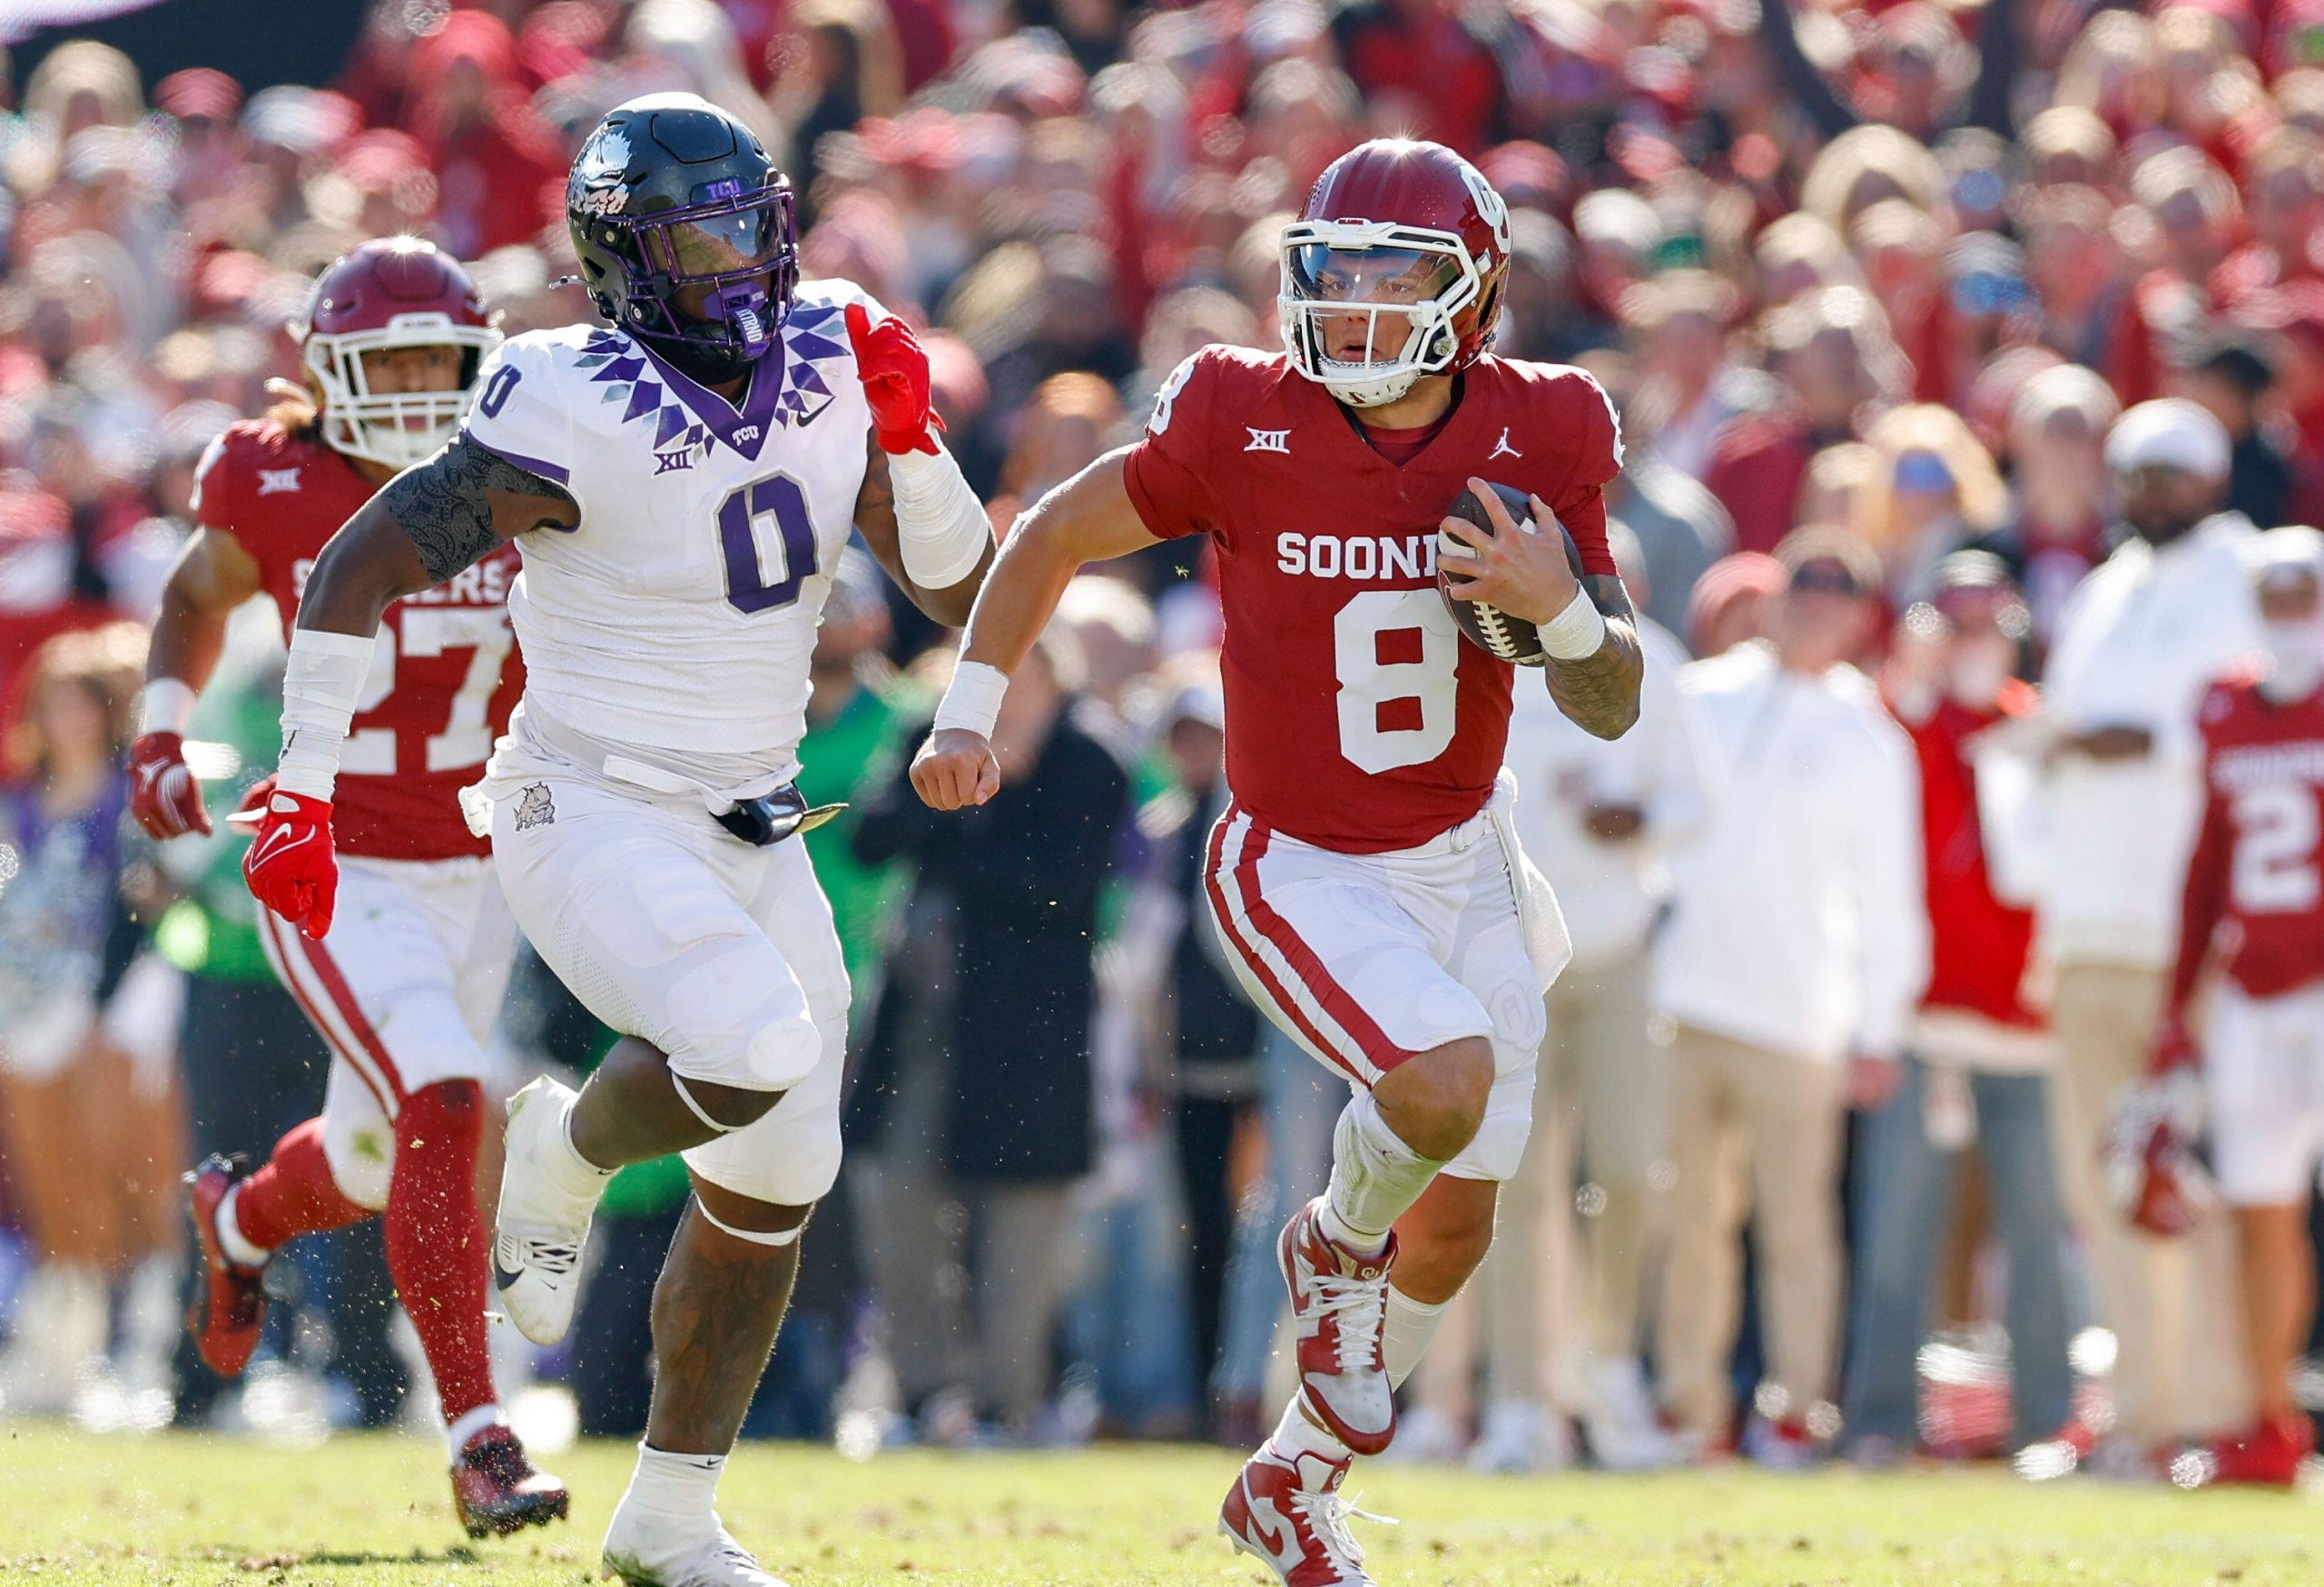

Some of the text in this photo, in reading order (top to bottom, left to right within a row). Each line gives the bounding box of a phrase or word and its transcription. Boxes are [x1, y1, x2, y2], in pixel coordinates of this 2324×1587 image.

[706, 178, 741, 199] TCU
[479, 363, 522, 419] 0
[1148, 360, 1195, 436] 8
[654, 448, 694, 476] XII
[732, 425, 760, 447] TCU
[1244, 426, 1292, 454] XII
[716, 468, 820, 615] 0
[1334, 587, 1460, 774] 8
[2228, 786, 2320, 914] 2
